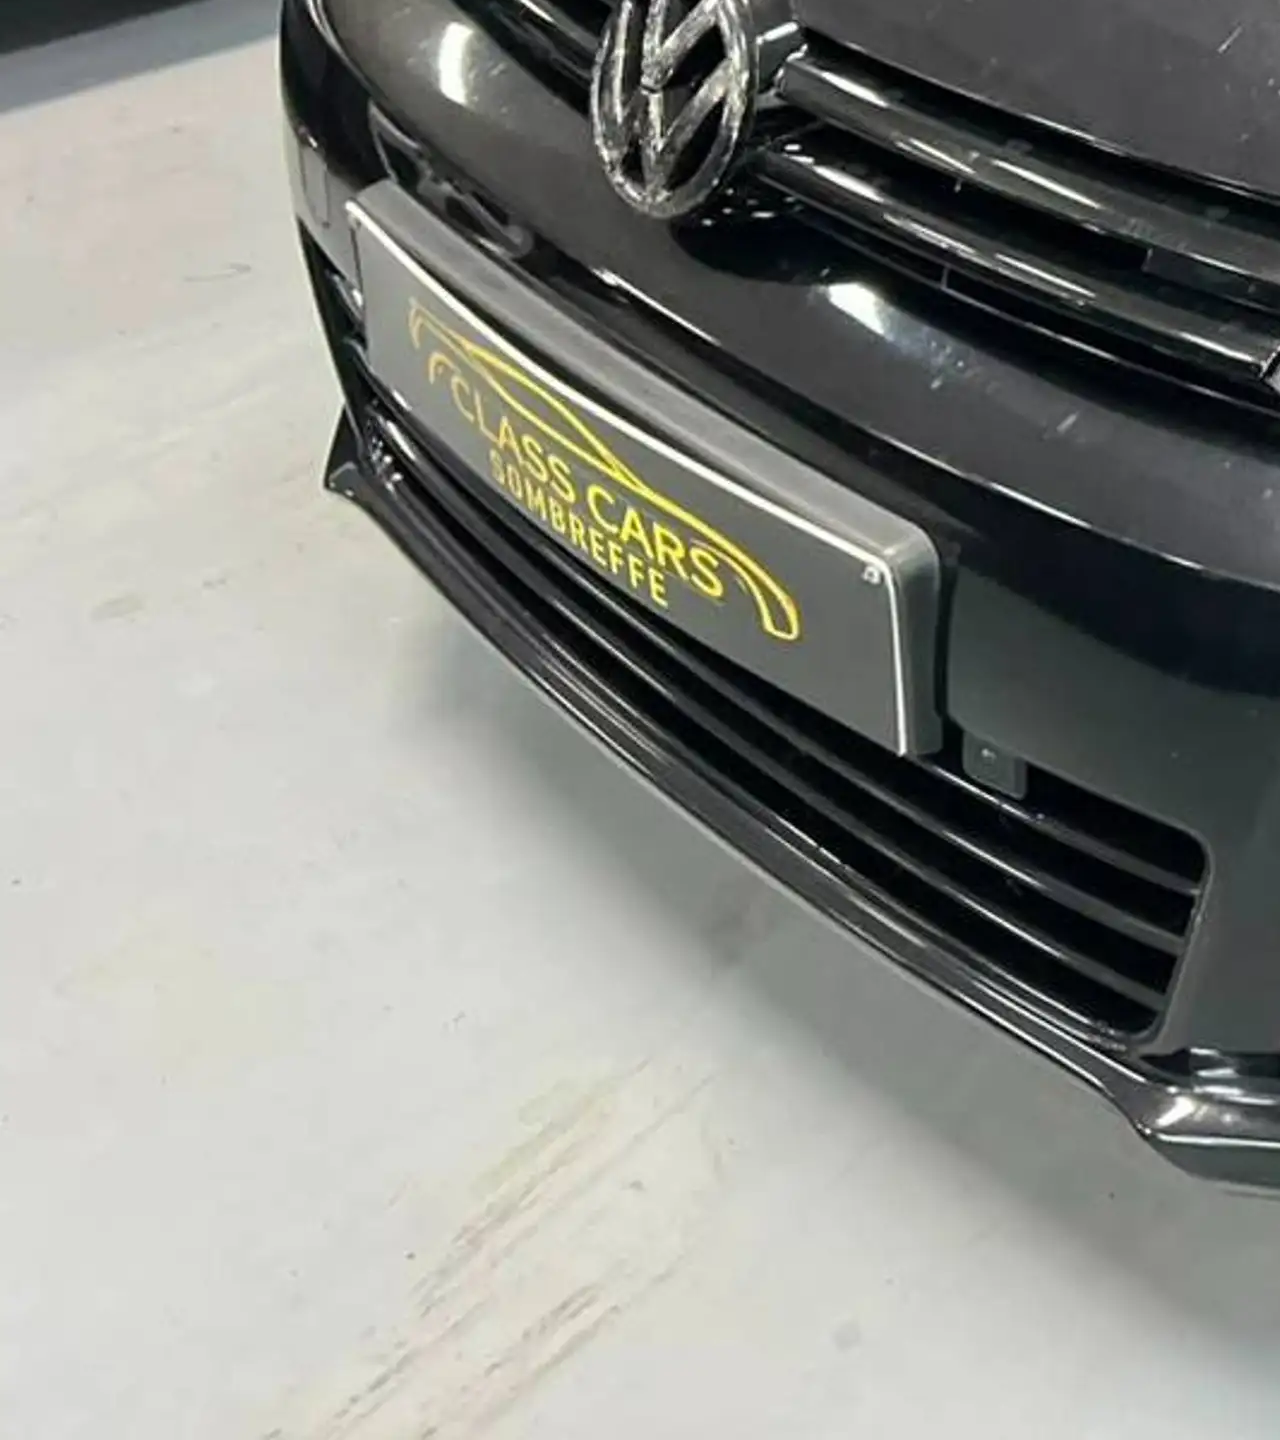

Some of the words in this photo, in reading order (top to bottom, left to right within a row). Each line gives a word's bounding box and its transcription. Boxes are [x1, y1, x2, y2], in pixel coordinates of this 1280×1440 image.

[451, 375, 575, 503] CLASS
[586, 483, 724, 598] CARS
[489, 448, 669, 609] SOMBREFFE
